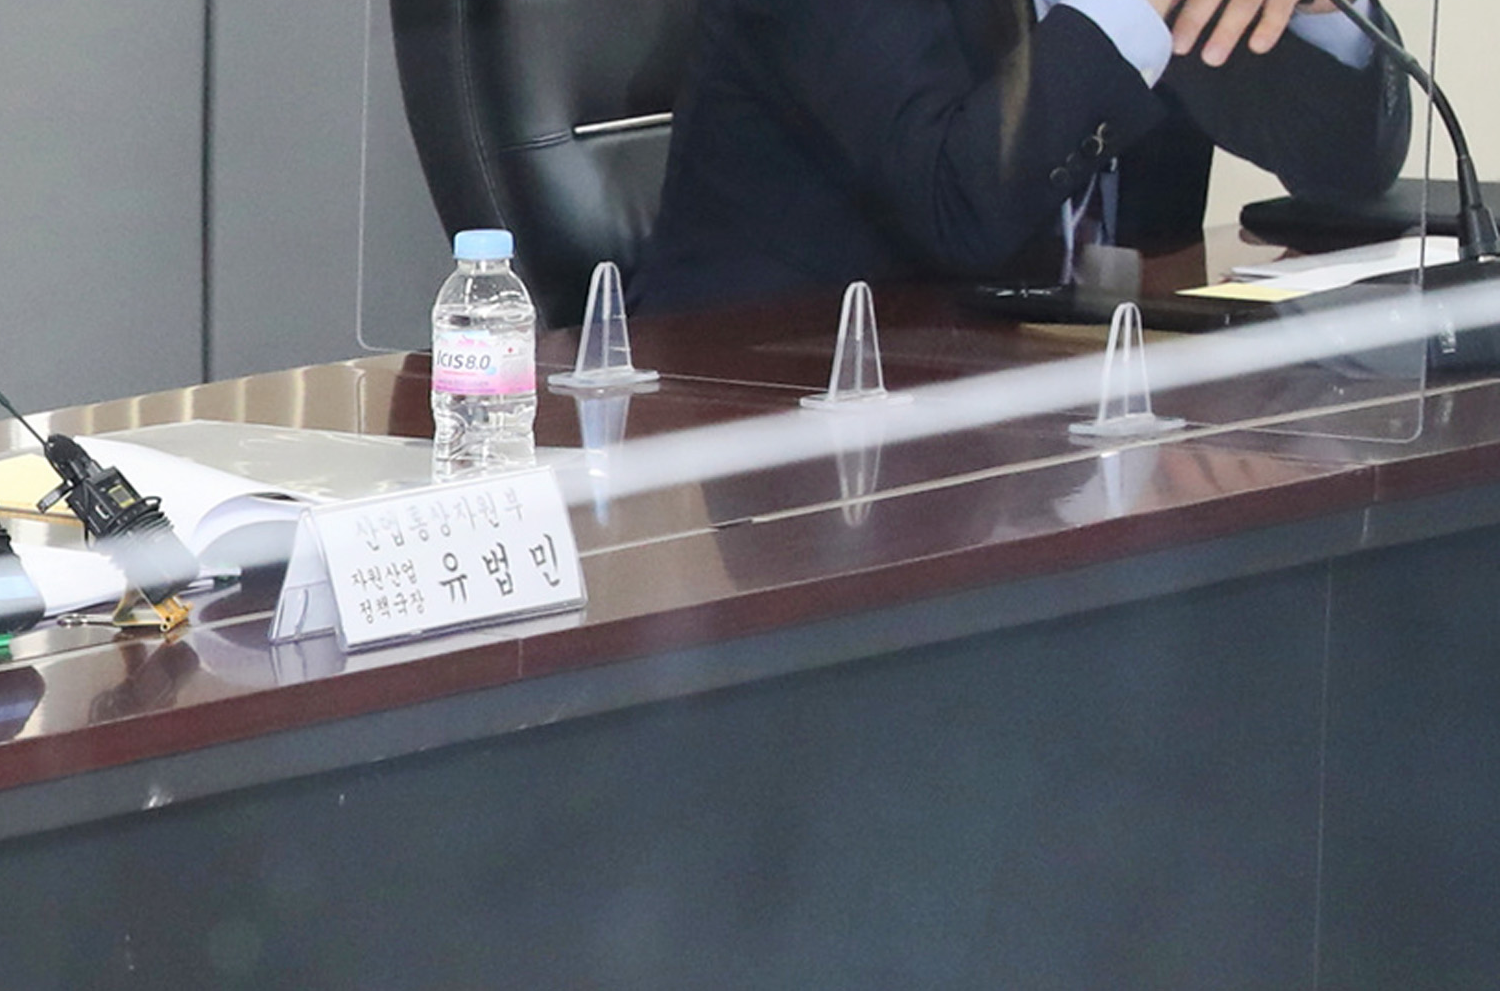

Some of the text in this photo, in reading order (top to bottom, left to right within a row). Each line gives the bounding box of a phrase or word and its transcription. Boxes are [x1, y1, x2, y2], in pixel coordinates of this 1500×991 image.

[355, 487, 524, 552] 산업통상자원부
[350, 559, 417, 592] 자원산업
[358, 590, 425, 625] 정책국장
